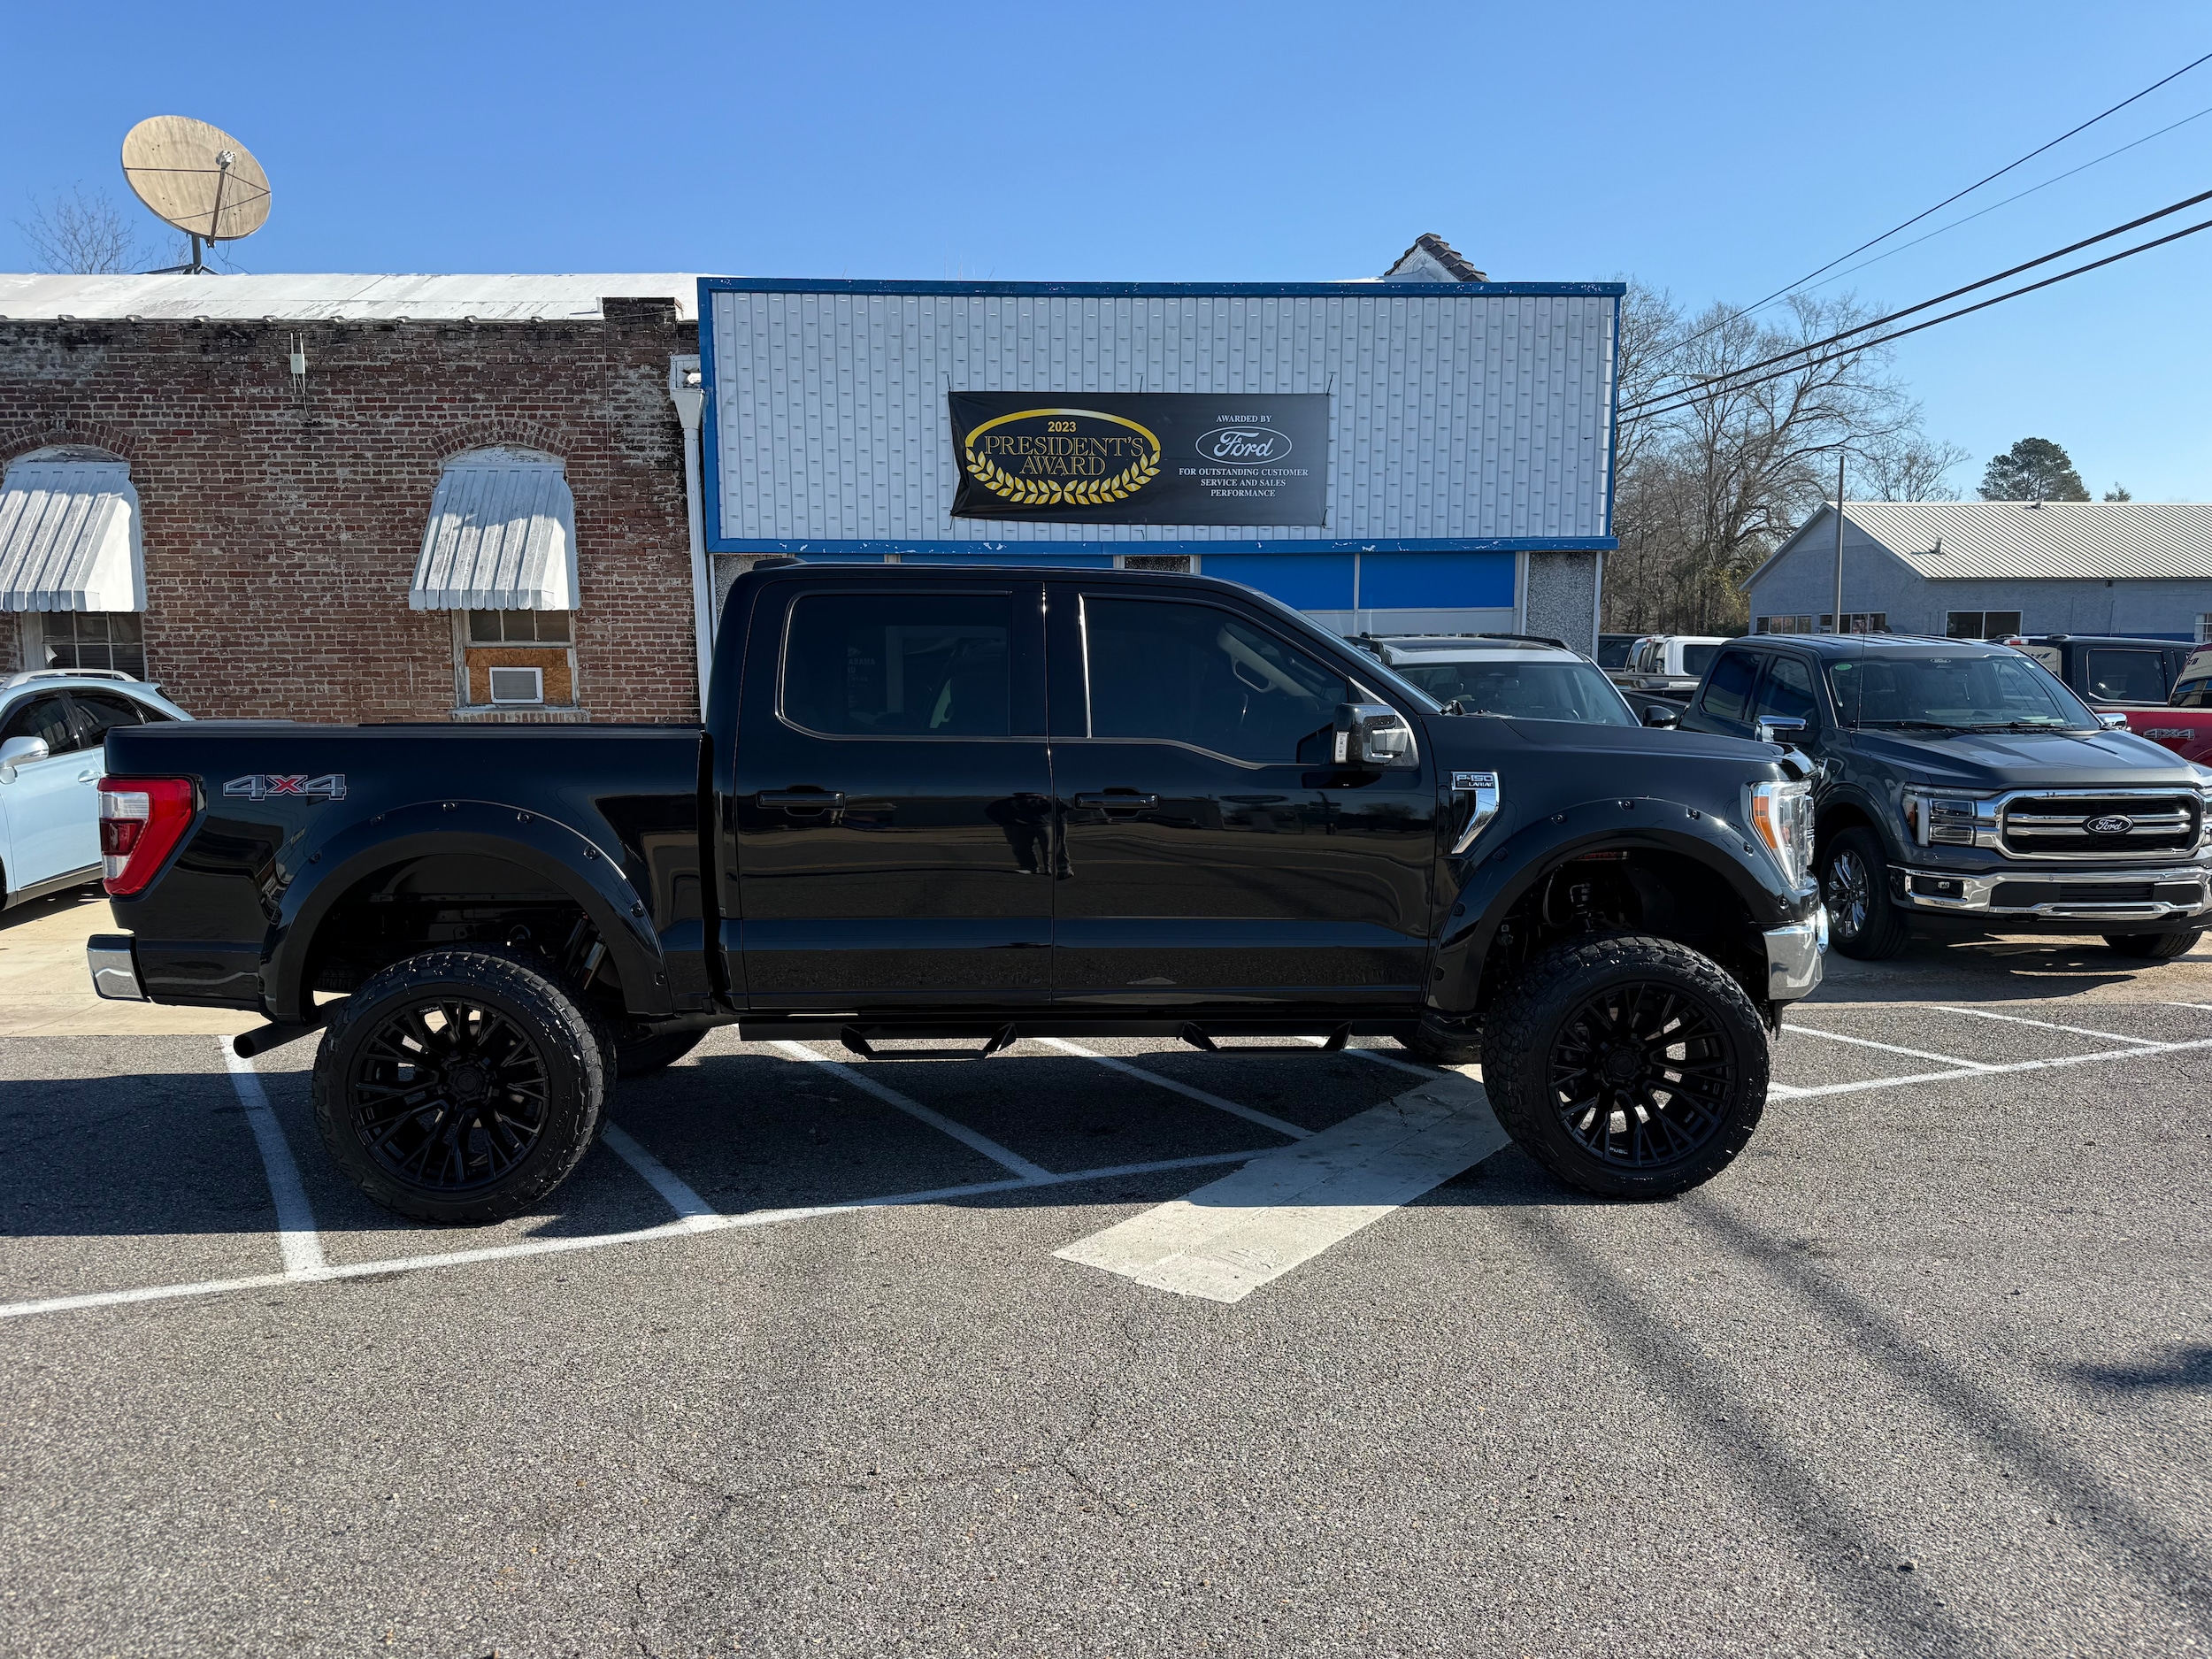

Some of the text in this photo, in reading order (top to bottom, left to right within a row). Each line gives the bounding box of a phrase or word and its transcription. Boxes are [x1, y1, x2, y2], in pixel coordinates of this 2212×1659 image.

[1216, 414, 1272, 423] AWARDED BY
[1047, 420, 1078, 434] 2023
[984, 435, 1144, 457] PRESIDENT'S
[1212, 430, 1274, 458] Ford
[1018, 456, 1107, 477] AWARD
[1178, 467, 1309, 477] FOR OUTSTANDING CUSTOMER
[1200, 478, 1286, 488] SERVICE AND SALES
[1210, 488, 1276, 498] PERFORMANCE
[2095, 818, 2123, 830] Ford
